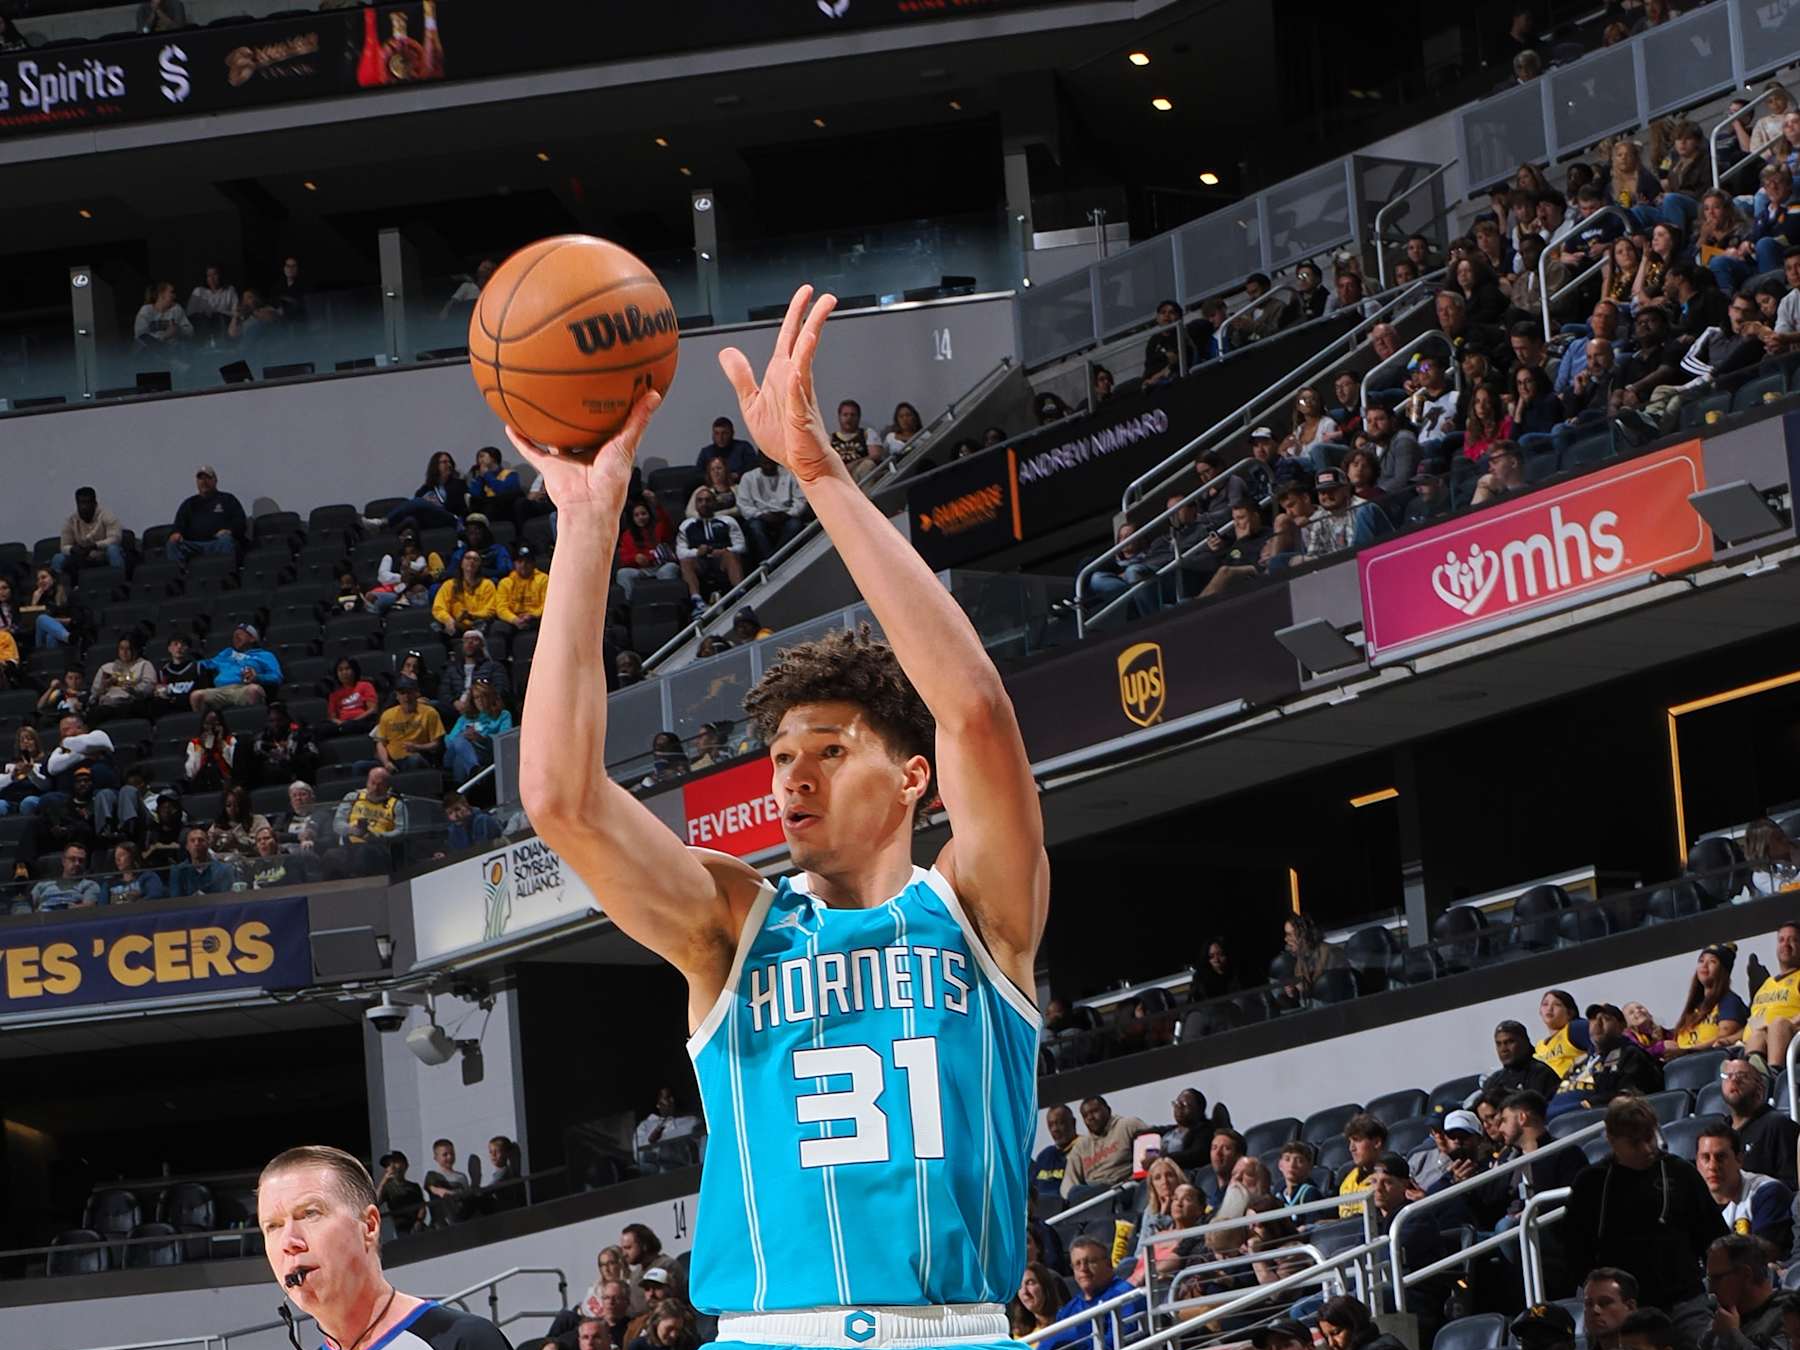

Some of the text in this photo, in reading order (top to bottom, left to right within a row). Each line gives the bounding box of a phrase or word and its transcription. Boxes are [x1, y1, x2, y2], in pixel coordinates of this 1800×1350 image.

[18, 59, 126, 113] Spirits
[568, 303, 678, 356] Wilson
[932, 327, 953, 361] 14
[1501, 505, 1625, 604] mhs
[1123, 666, 1161, 714] ups
[687, 793, 784, 846] FEVERTE
[513, 855, 560, 882] SOYBEAN
[516, 871, 561, 899] ALLIANCE
[0, 921, 275, 999] ES 'CERS
[748, 945, 970, 1032] HORNETS
[792, 1035, 945, 1170] 31
[673, 1200, 687, 1240] 14
